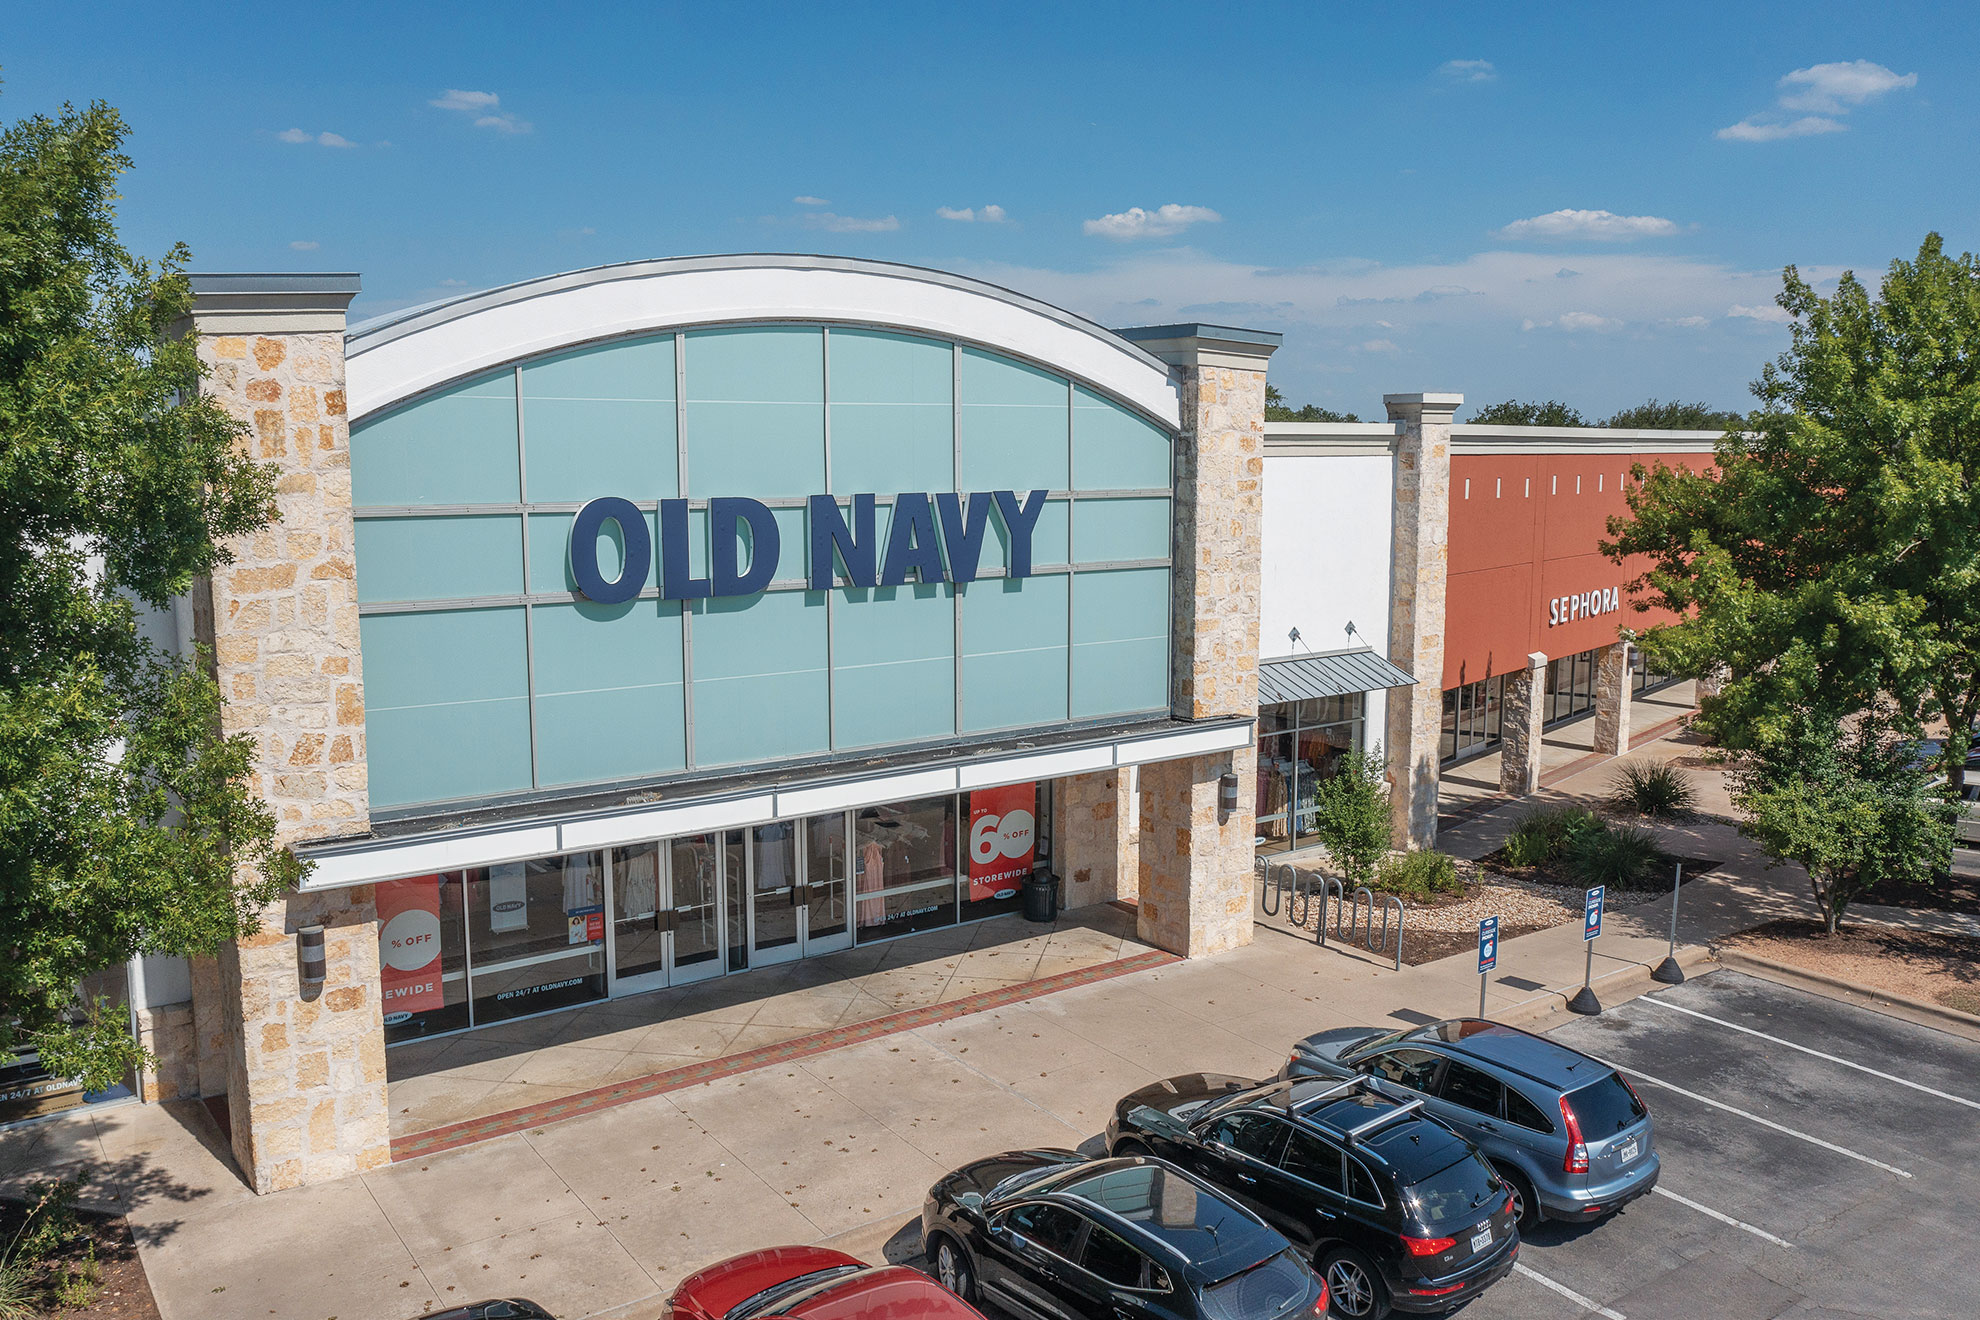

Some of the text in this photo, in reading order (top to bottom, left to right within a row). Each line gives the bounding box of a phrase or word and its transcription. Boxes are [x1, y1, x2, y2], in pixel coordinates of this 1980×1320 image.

[568, 489, 1049, 604] OLD NAVY
[1549, 586, 1619, 626] SEPHORA
[970, 809, 1035, 865] 60
[1003, 829, 1029, 840] % OFF
[973, 867, 1028, 886] STOREWIDE
[506, 902, 522, 910] NAVY
[391, 933, 432, 949] % OFF
[382, 982, 434, 1000] EWIDE
[496, 977, 583, 1001] OPEN 24/7 AT OLDNAVY.COM
[393, 1013, 408, 1021] NAVY
[10, 1088, 31, 1099] 24/7
[34, 1085, 44, 1095] AT
